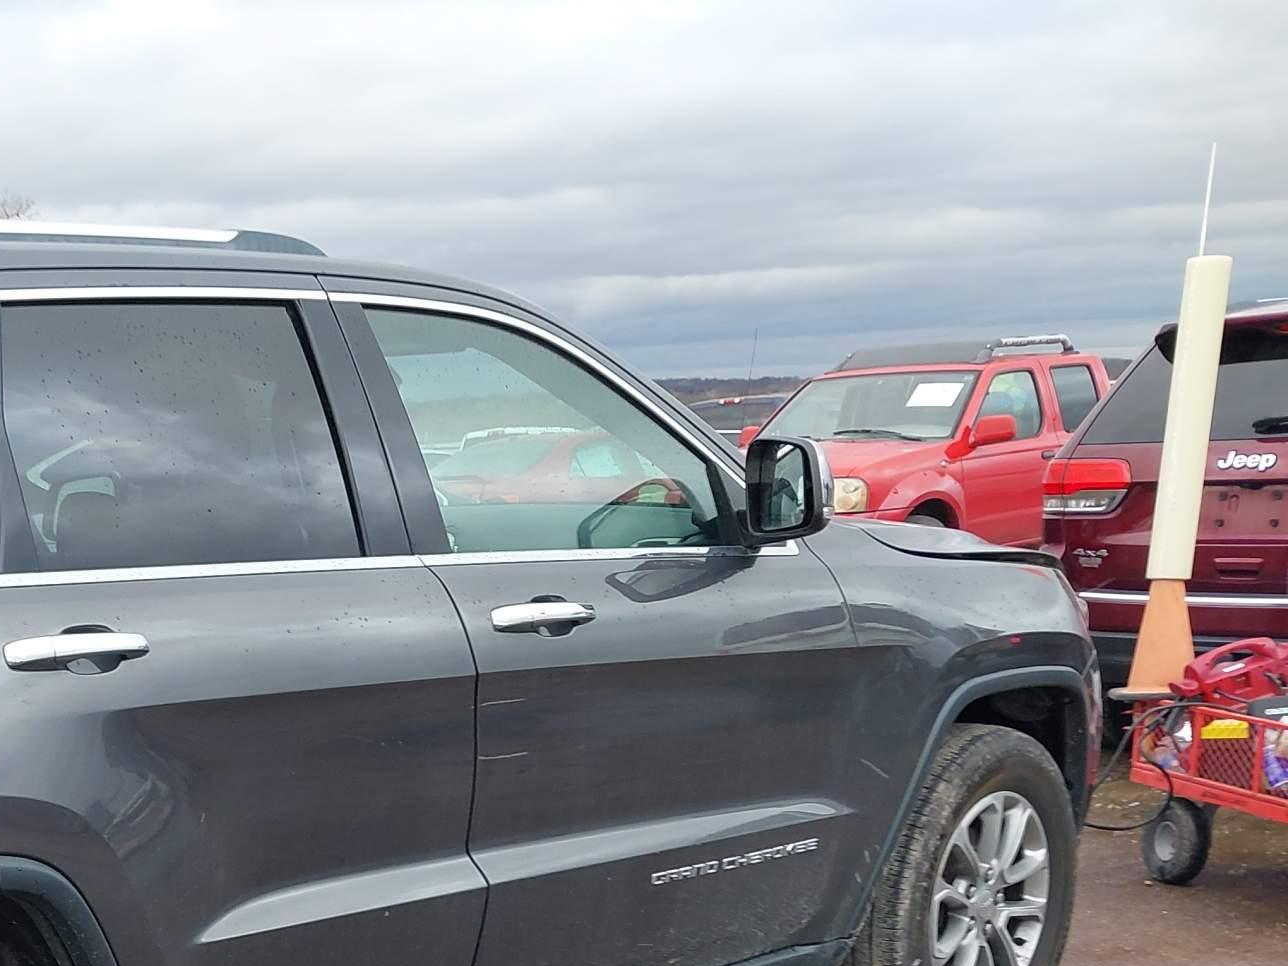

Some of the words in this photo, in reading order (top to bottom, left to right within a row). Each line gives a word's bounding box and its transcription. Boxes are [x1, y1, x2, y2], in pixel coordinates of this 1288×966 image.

[1217, 450, 1277, 471] Jeep
[1072, 548, 1109, 556] 4x4
[651, 860, 719, 885] GRAND
[722, 838, 819, 870] CHEROKEE
